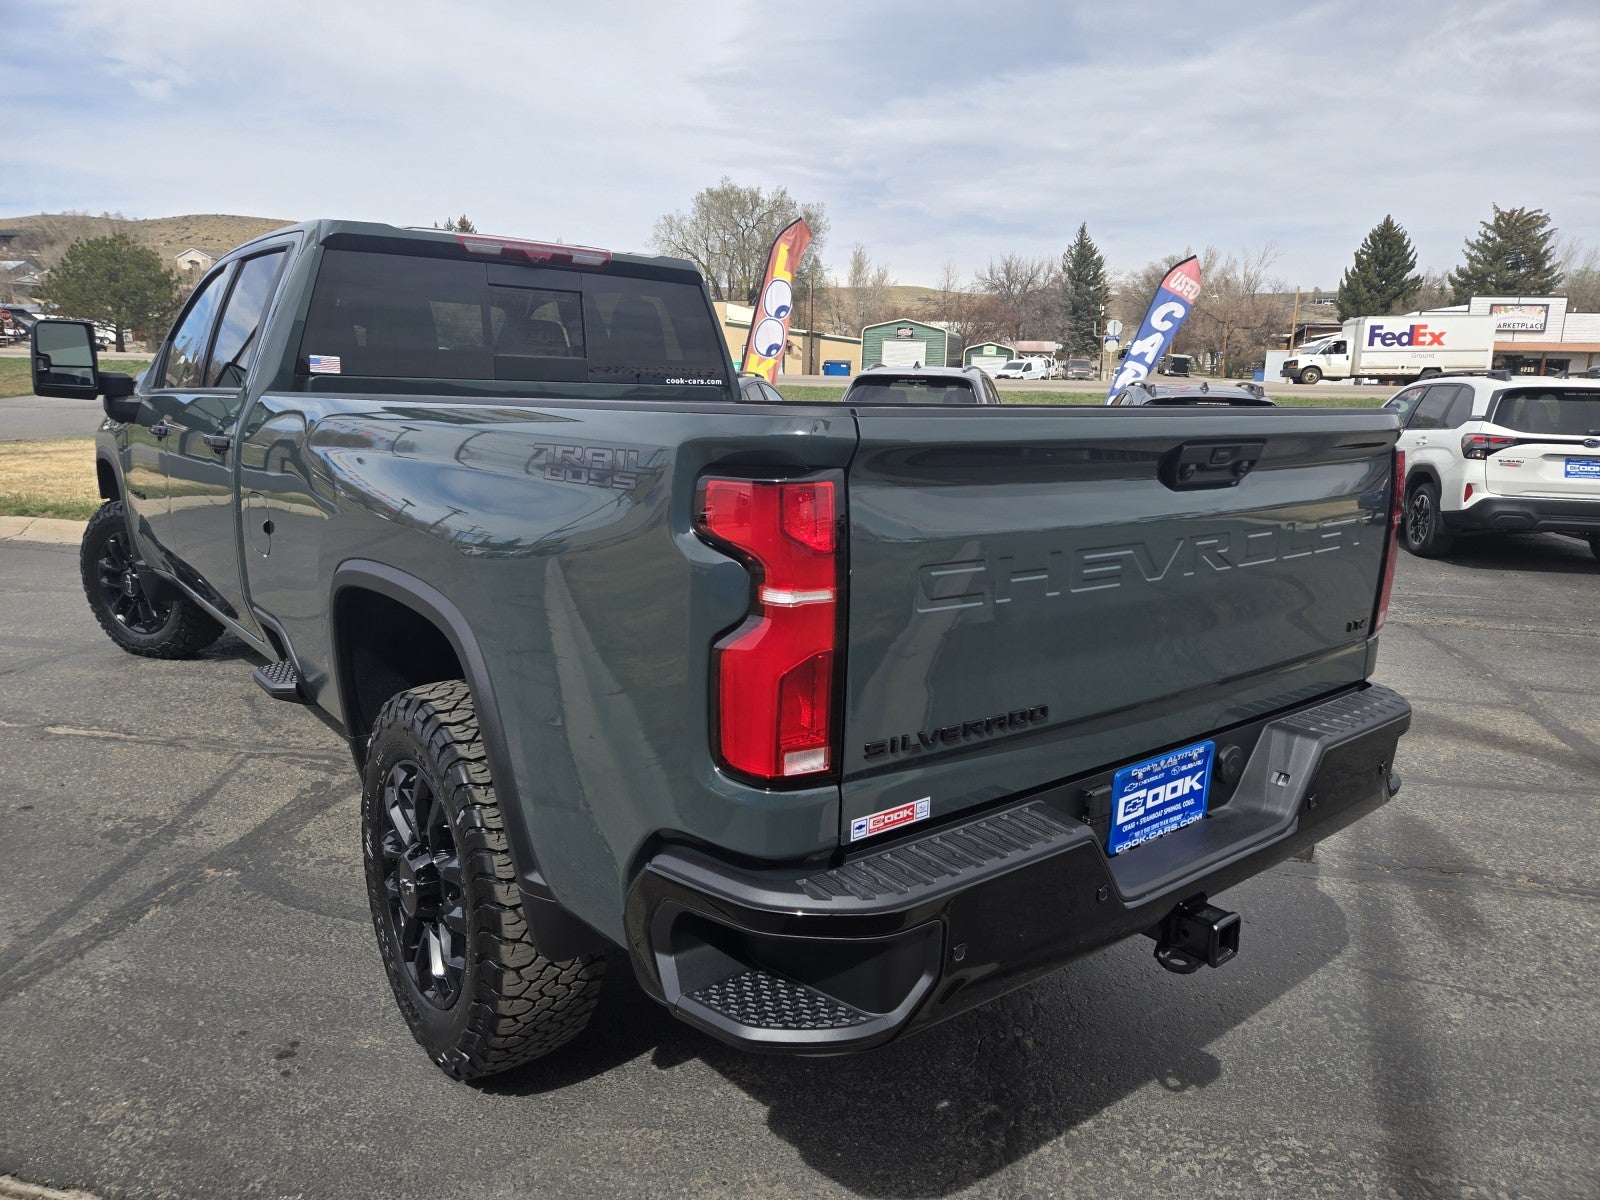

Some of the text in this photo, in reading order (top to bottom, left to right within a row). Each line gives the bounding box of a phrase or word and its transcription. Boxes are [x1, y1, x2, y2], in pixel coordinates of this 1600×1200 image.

[1169, 271, 1201, 300] USED
[1368, 324, 1448, 347] FedEx
[1496, 322, 1544, 330] ARKETPLACE
[1106, 302, 1186, 406] CAR
[1411, 351, 1436, 360] Ground
[665, 377, 723, 385] cook-cars.com
[533, 443, 658, 475] TRAIL
[543, 463, 638, 491] BOSS
[916, 512, 1374, 613] CHEVROLET
[864, 704, 1050, 761] SILVERADO
[1116, 771, 1205, 826] COOK
[869, 806, 914, 830] COOK
